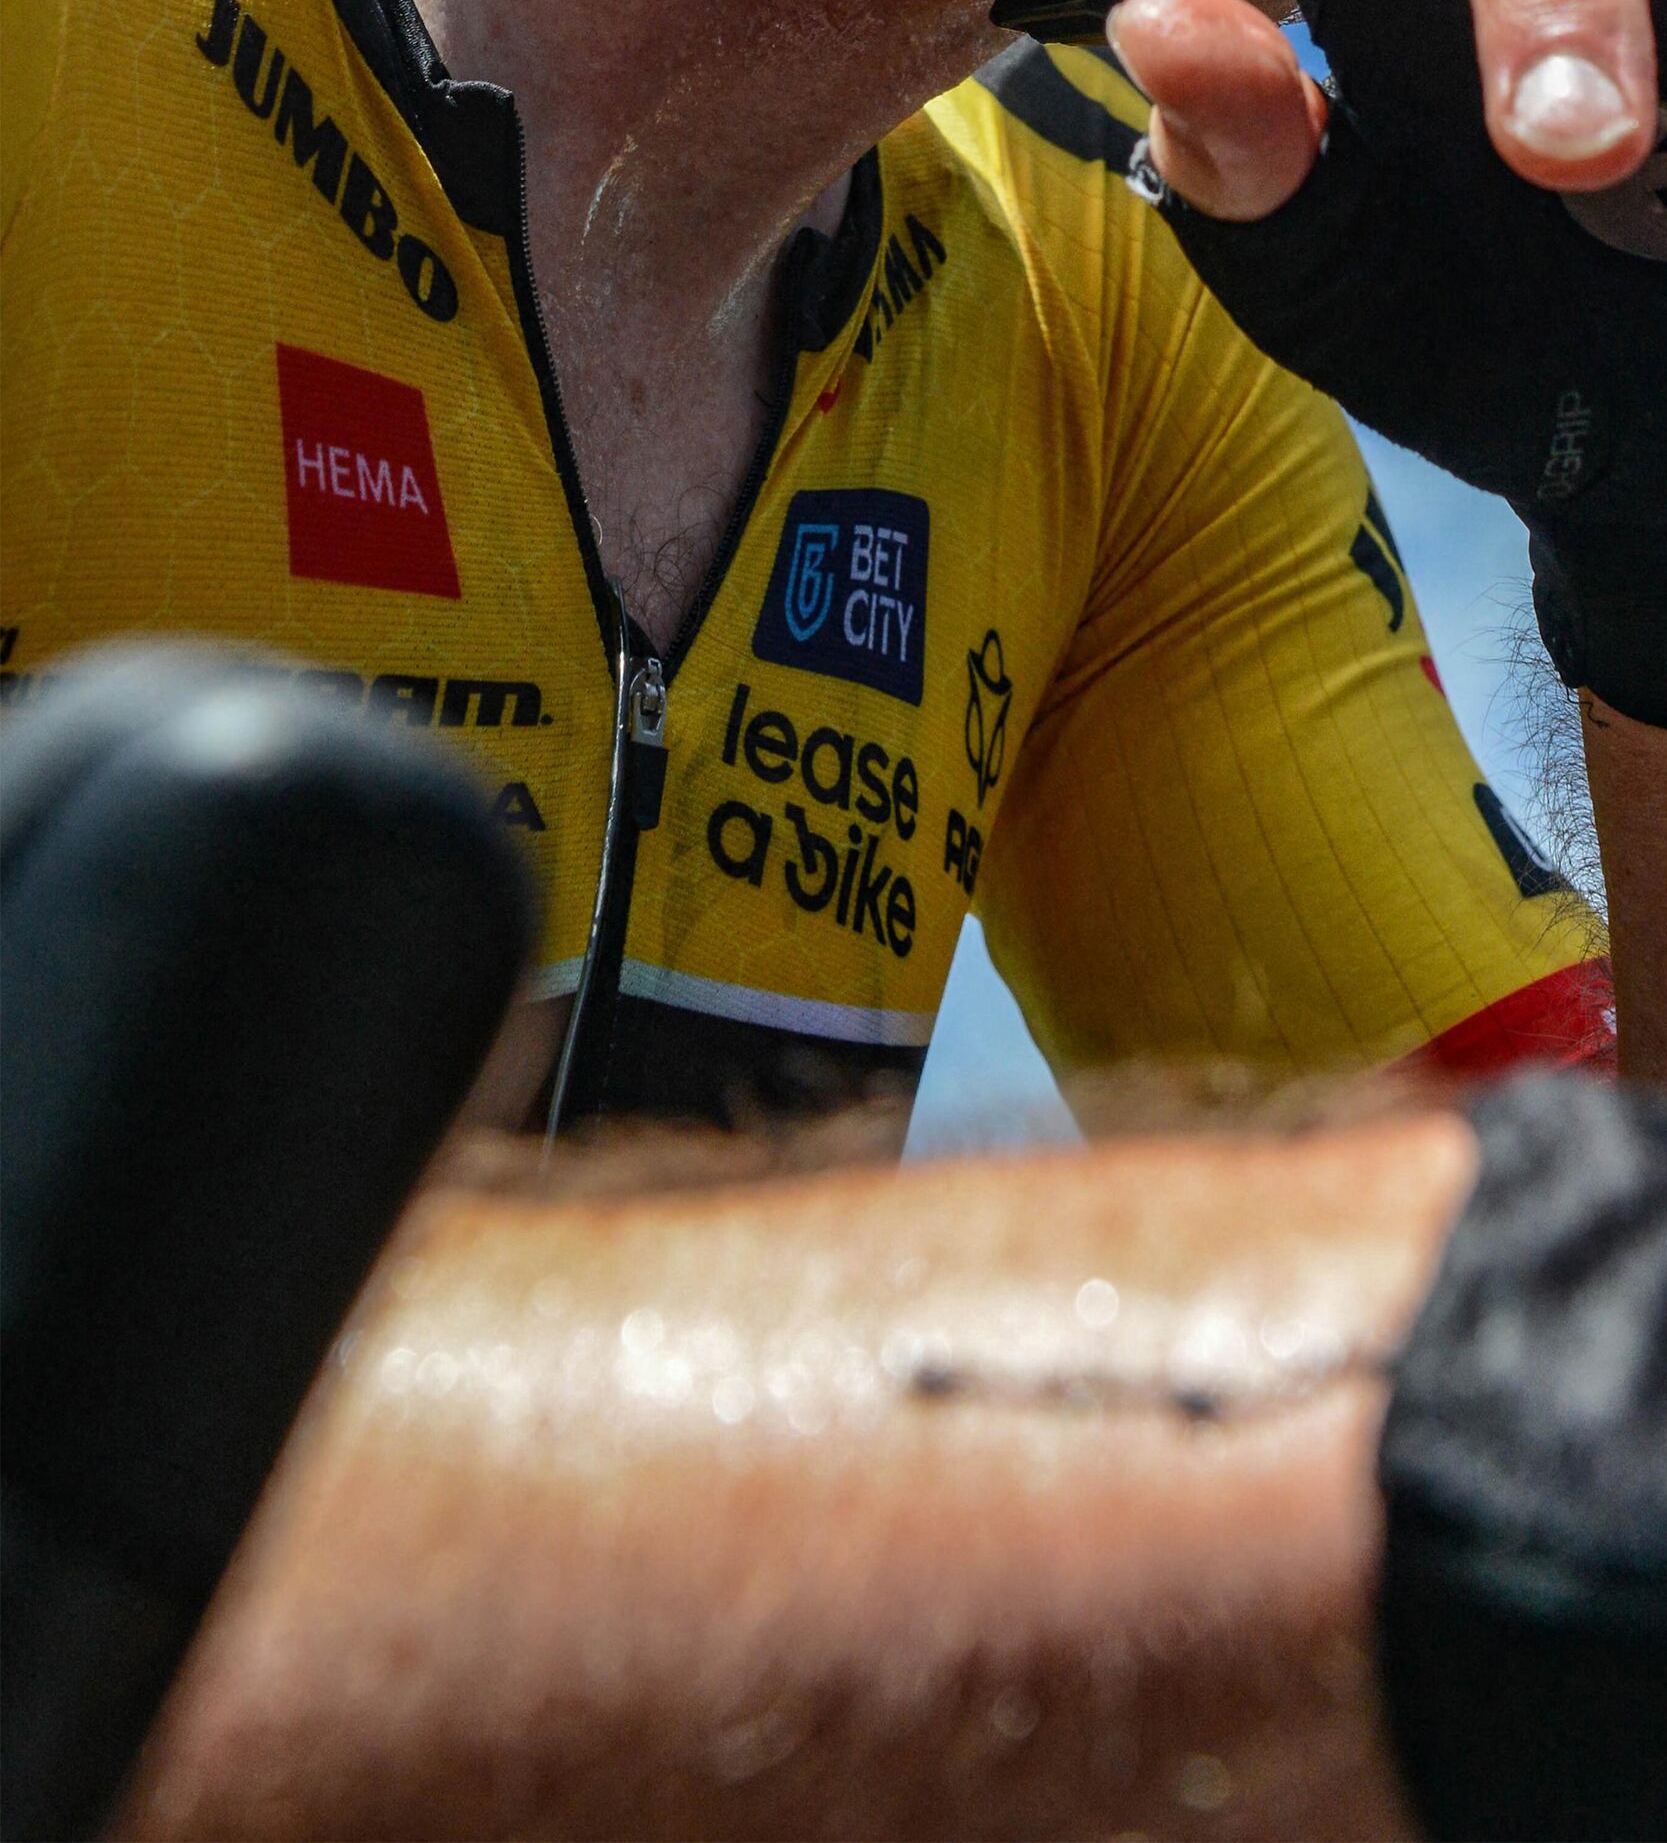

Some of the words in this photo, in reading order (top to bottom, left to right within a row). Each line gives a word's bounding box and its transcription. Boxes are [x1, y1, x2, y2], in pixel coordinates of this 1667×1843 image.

[296, 438, 429, 517] HEMA
[850, 524, 909, 591] BET
[843, 589, 914, 663] CITY
[721, 683, 919, 841] lease
[706, 797, 772, 890] a
